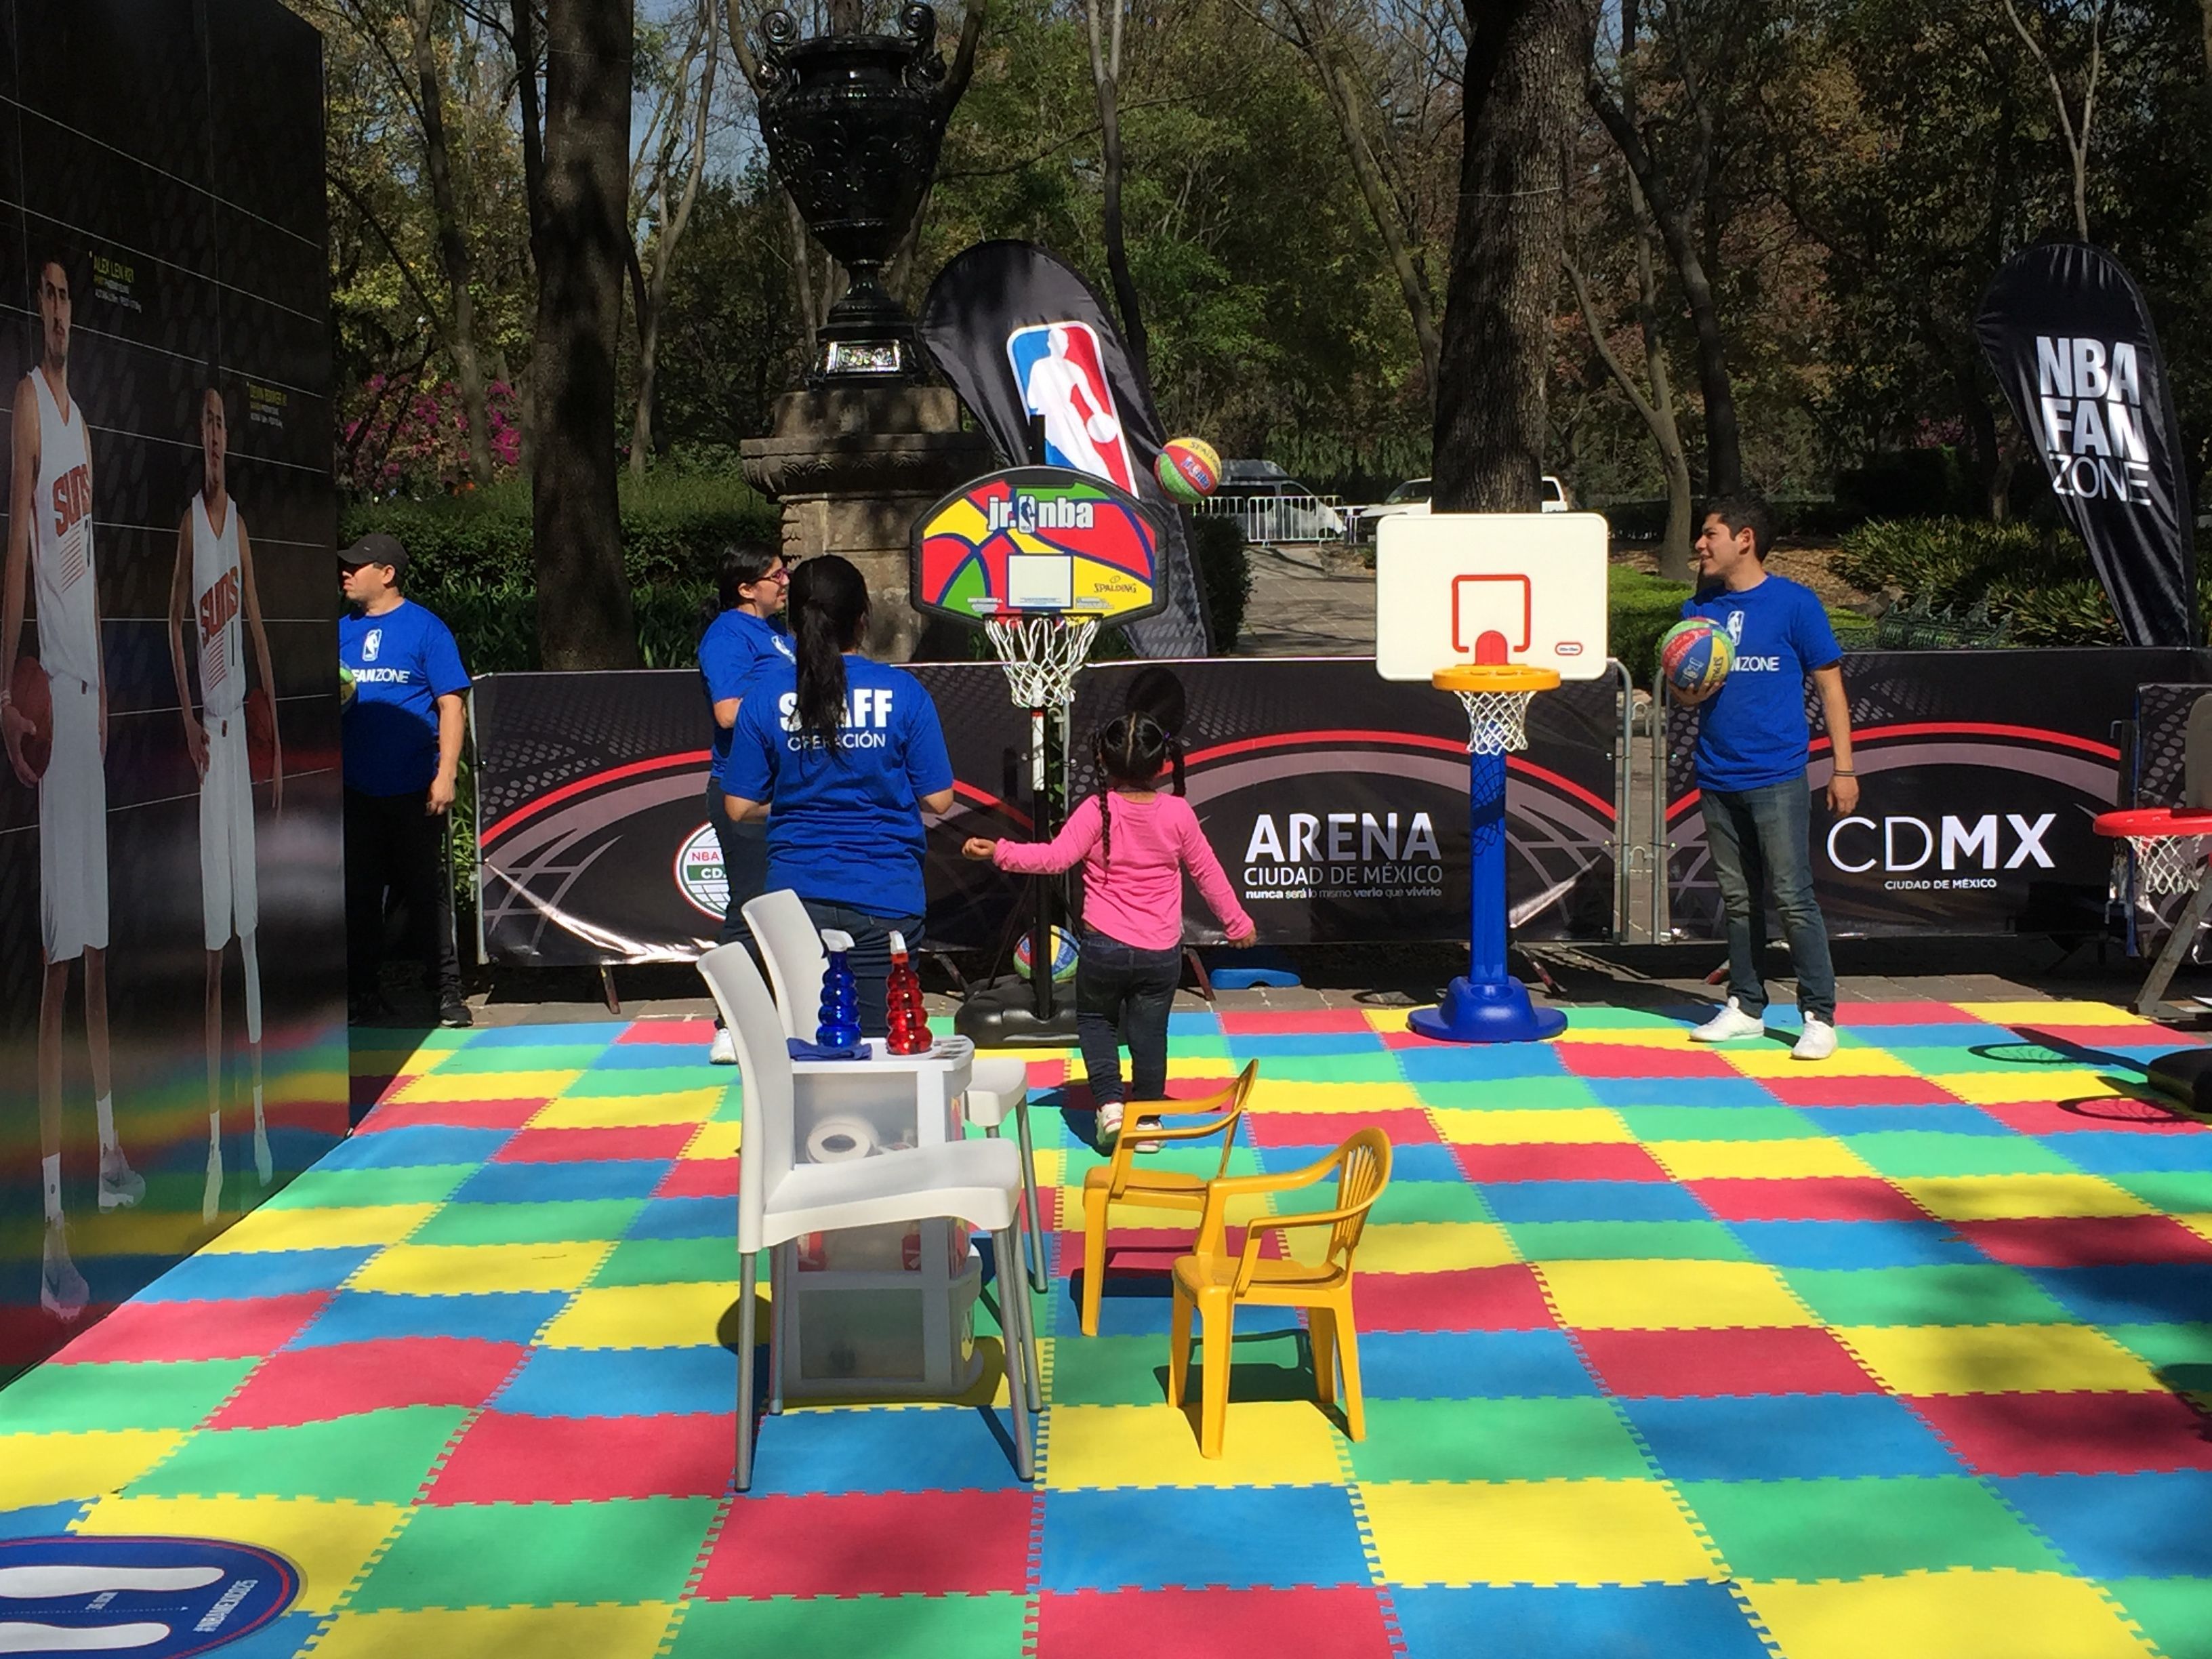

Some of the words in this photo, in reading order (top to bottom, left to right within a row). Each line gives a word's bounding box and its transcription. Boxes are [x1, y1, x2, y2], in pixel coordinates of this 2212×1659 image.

[2036, 336, 2141, 405] NBA
[2041, 396, 2149, 462] FAN
[53, 464, 91, 537] SUNS
[2049, 453, 2151, 506] ZONE
[988, 497, 1017, 531] jr.
[1038, 497, 1094, 529] nba
[200, 565, 239, 649] SUNS
[1094, 583, 1136, 593] SPALDING
[1729, 656, 1780, 672] NZONE
[779, 689, 893, 732] SAFF
[692, 851, 720, 861] NBA
[1244, 813, 1442, 863] ARENA
[1827, 814, 2057, 873] CDMX
[1244, 866, 1324, 886] CIUDAD
[1330, 866, 1357, 884] DE
[1364, 862, 1443, 884] MÉXICO
[1246, 890, 1284, 899] nunca
[1285, 888, 1307, 899] será
[1308, 888, 1317, 899] lo
[1319, 888, 1351, 899] mismo
[1353, 887, 1384, 898] verlo
[1385, 888, 1404, 899] que
[1405, 886, 1442, 897] vivirlo
[1885, 880, 1931, 890] CIUDAD
[1933, 880, 1950, 890] DE
[1952, 878, 1997, 889] MÉXICO
